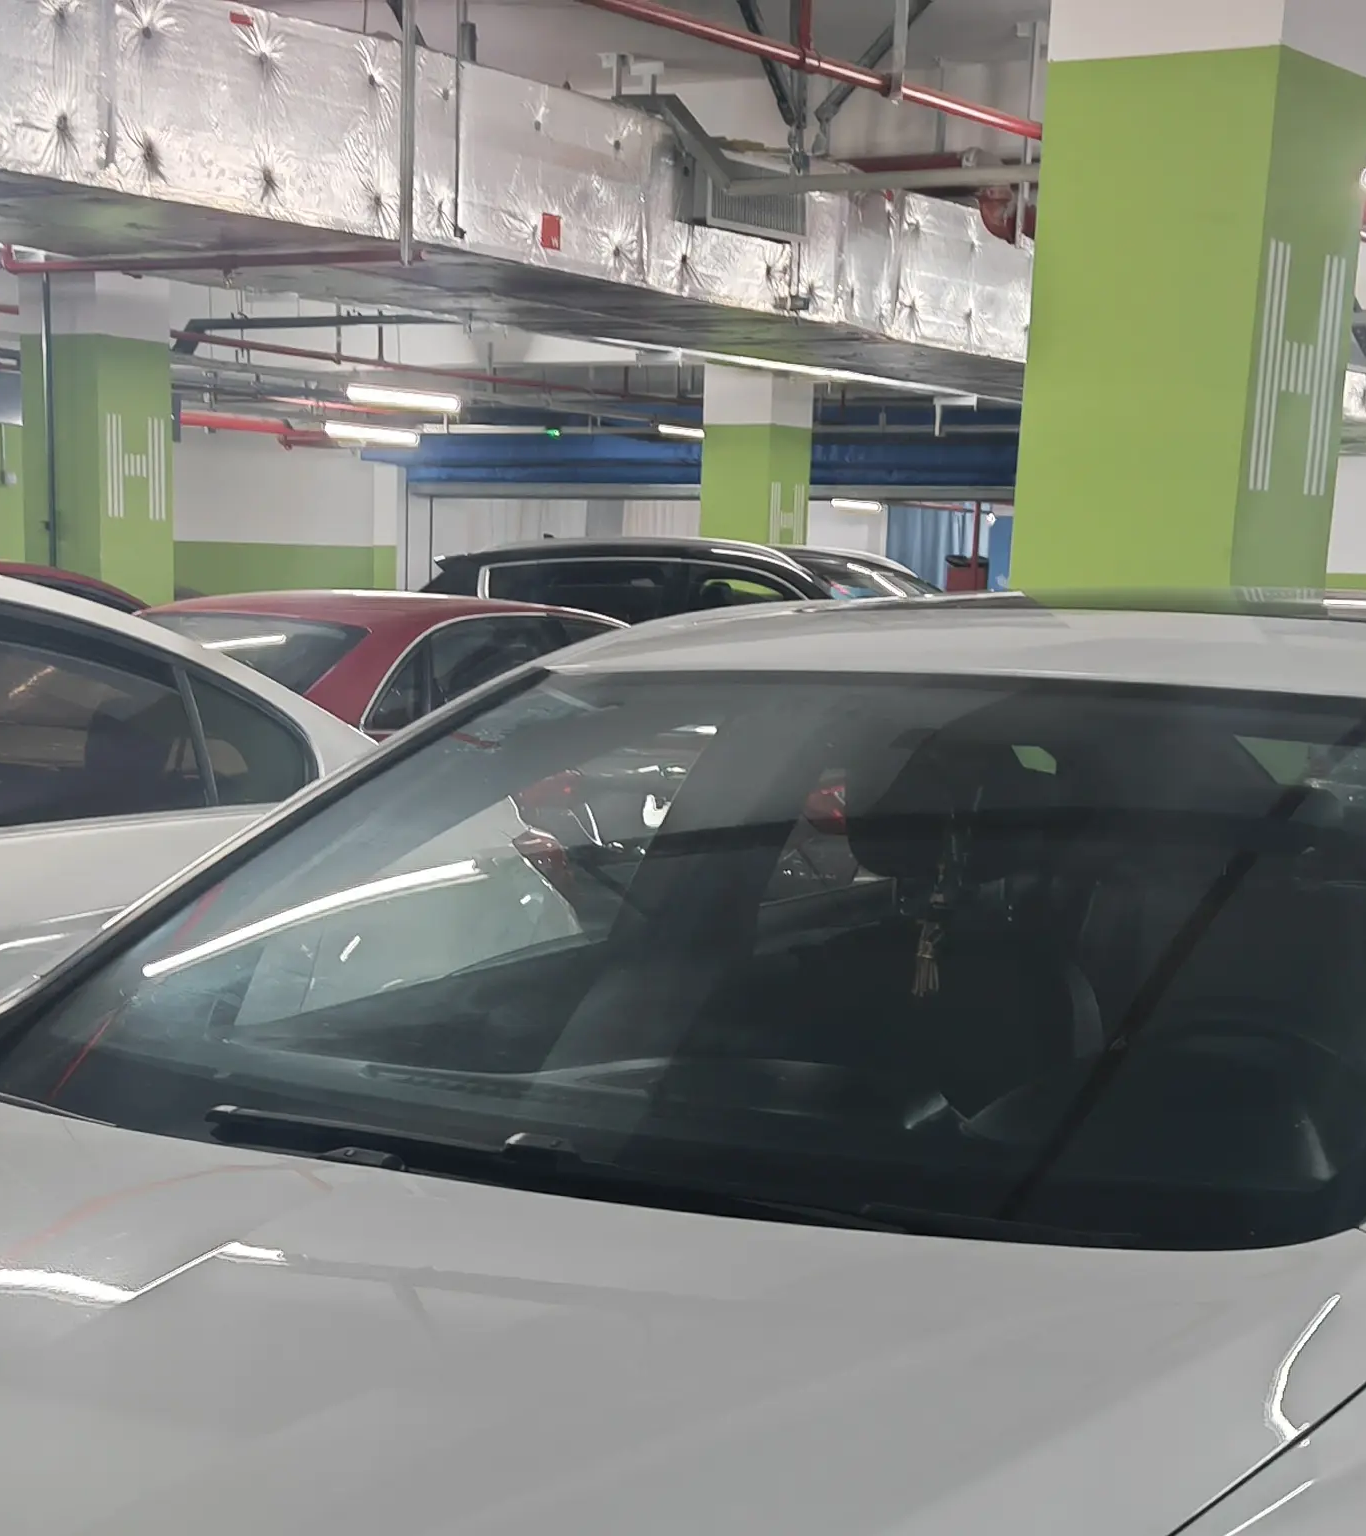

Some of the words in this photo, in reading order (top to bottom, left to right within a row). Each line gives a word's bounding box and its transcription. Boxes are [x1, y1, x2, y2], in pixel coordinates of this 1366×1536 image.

[1248, 238, 1346, 496] H
[107, 412, 166, 521] H
[769, 481, 805, 546] H
